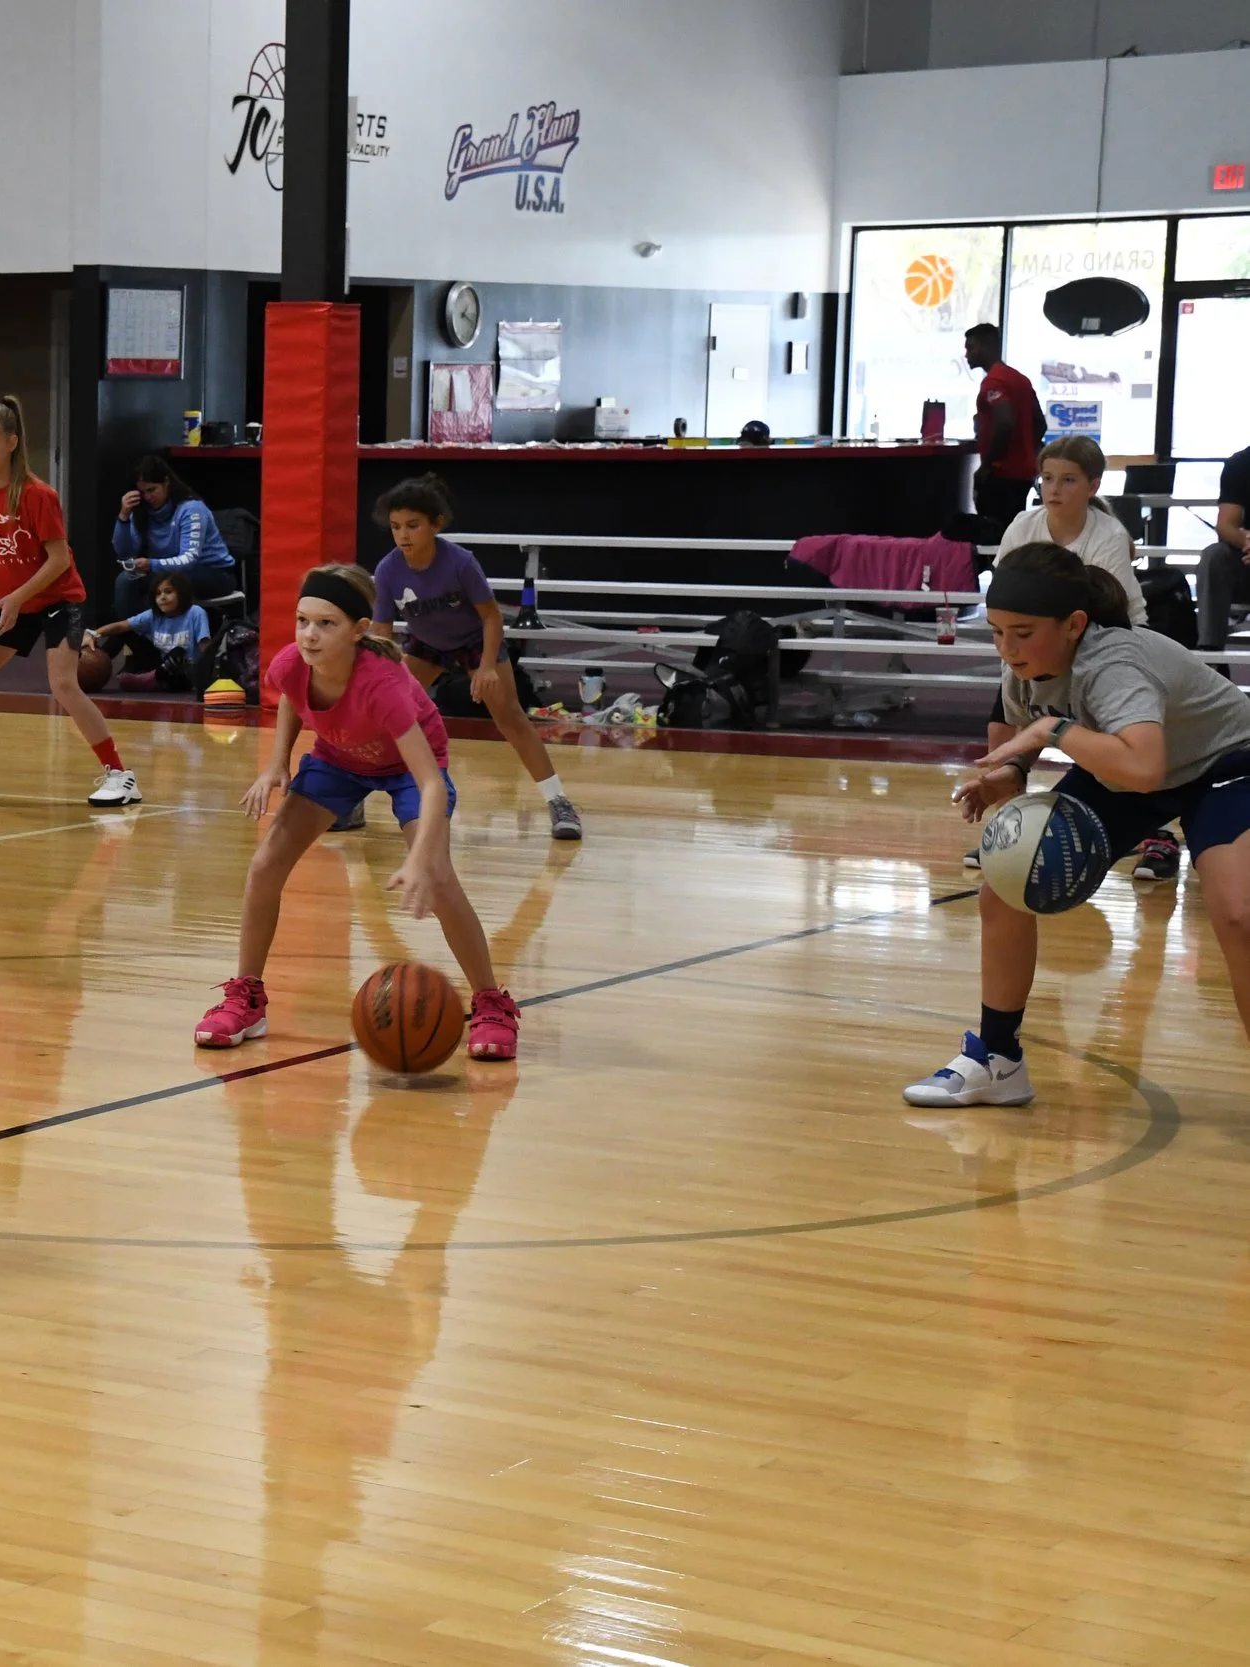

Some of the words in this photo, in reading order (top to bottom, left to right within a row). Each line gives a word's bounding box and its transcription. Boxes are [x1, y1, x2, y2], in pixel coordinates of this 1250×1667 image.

[356, 113, 387, 138] RTS
[354, 144, 390, 157] FACILITY
[445, 113, 519, 201] Grand
[520, 101, 580, 161] Slam
[515, 173, 564, 213] U.S.A.
